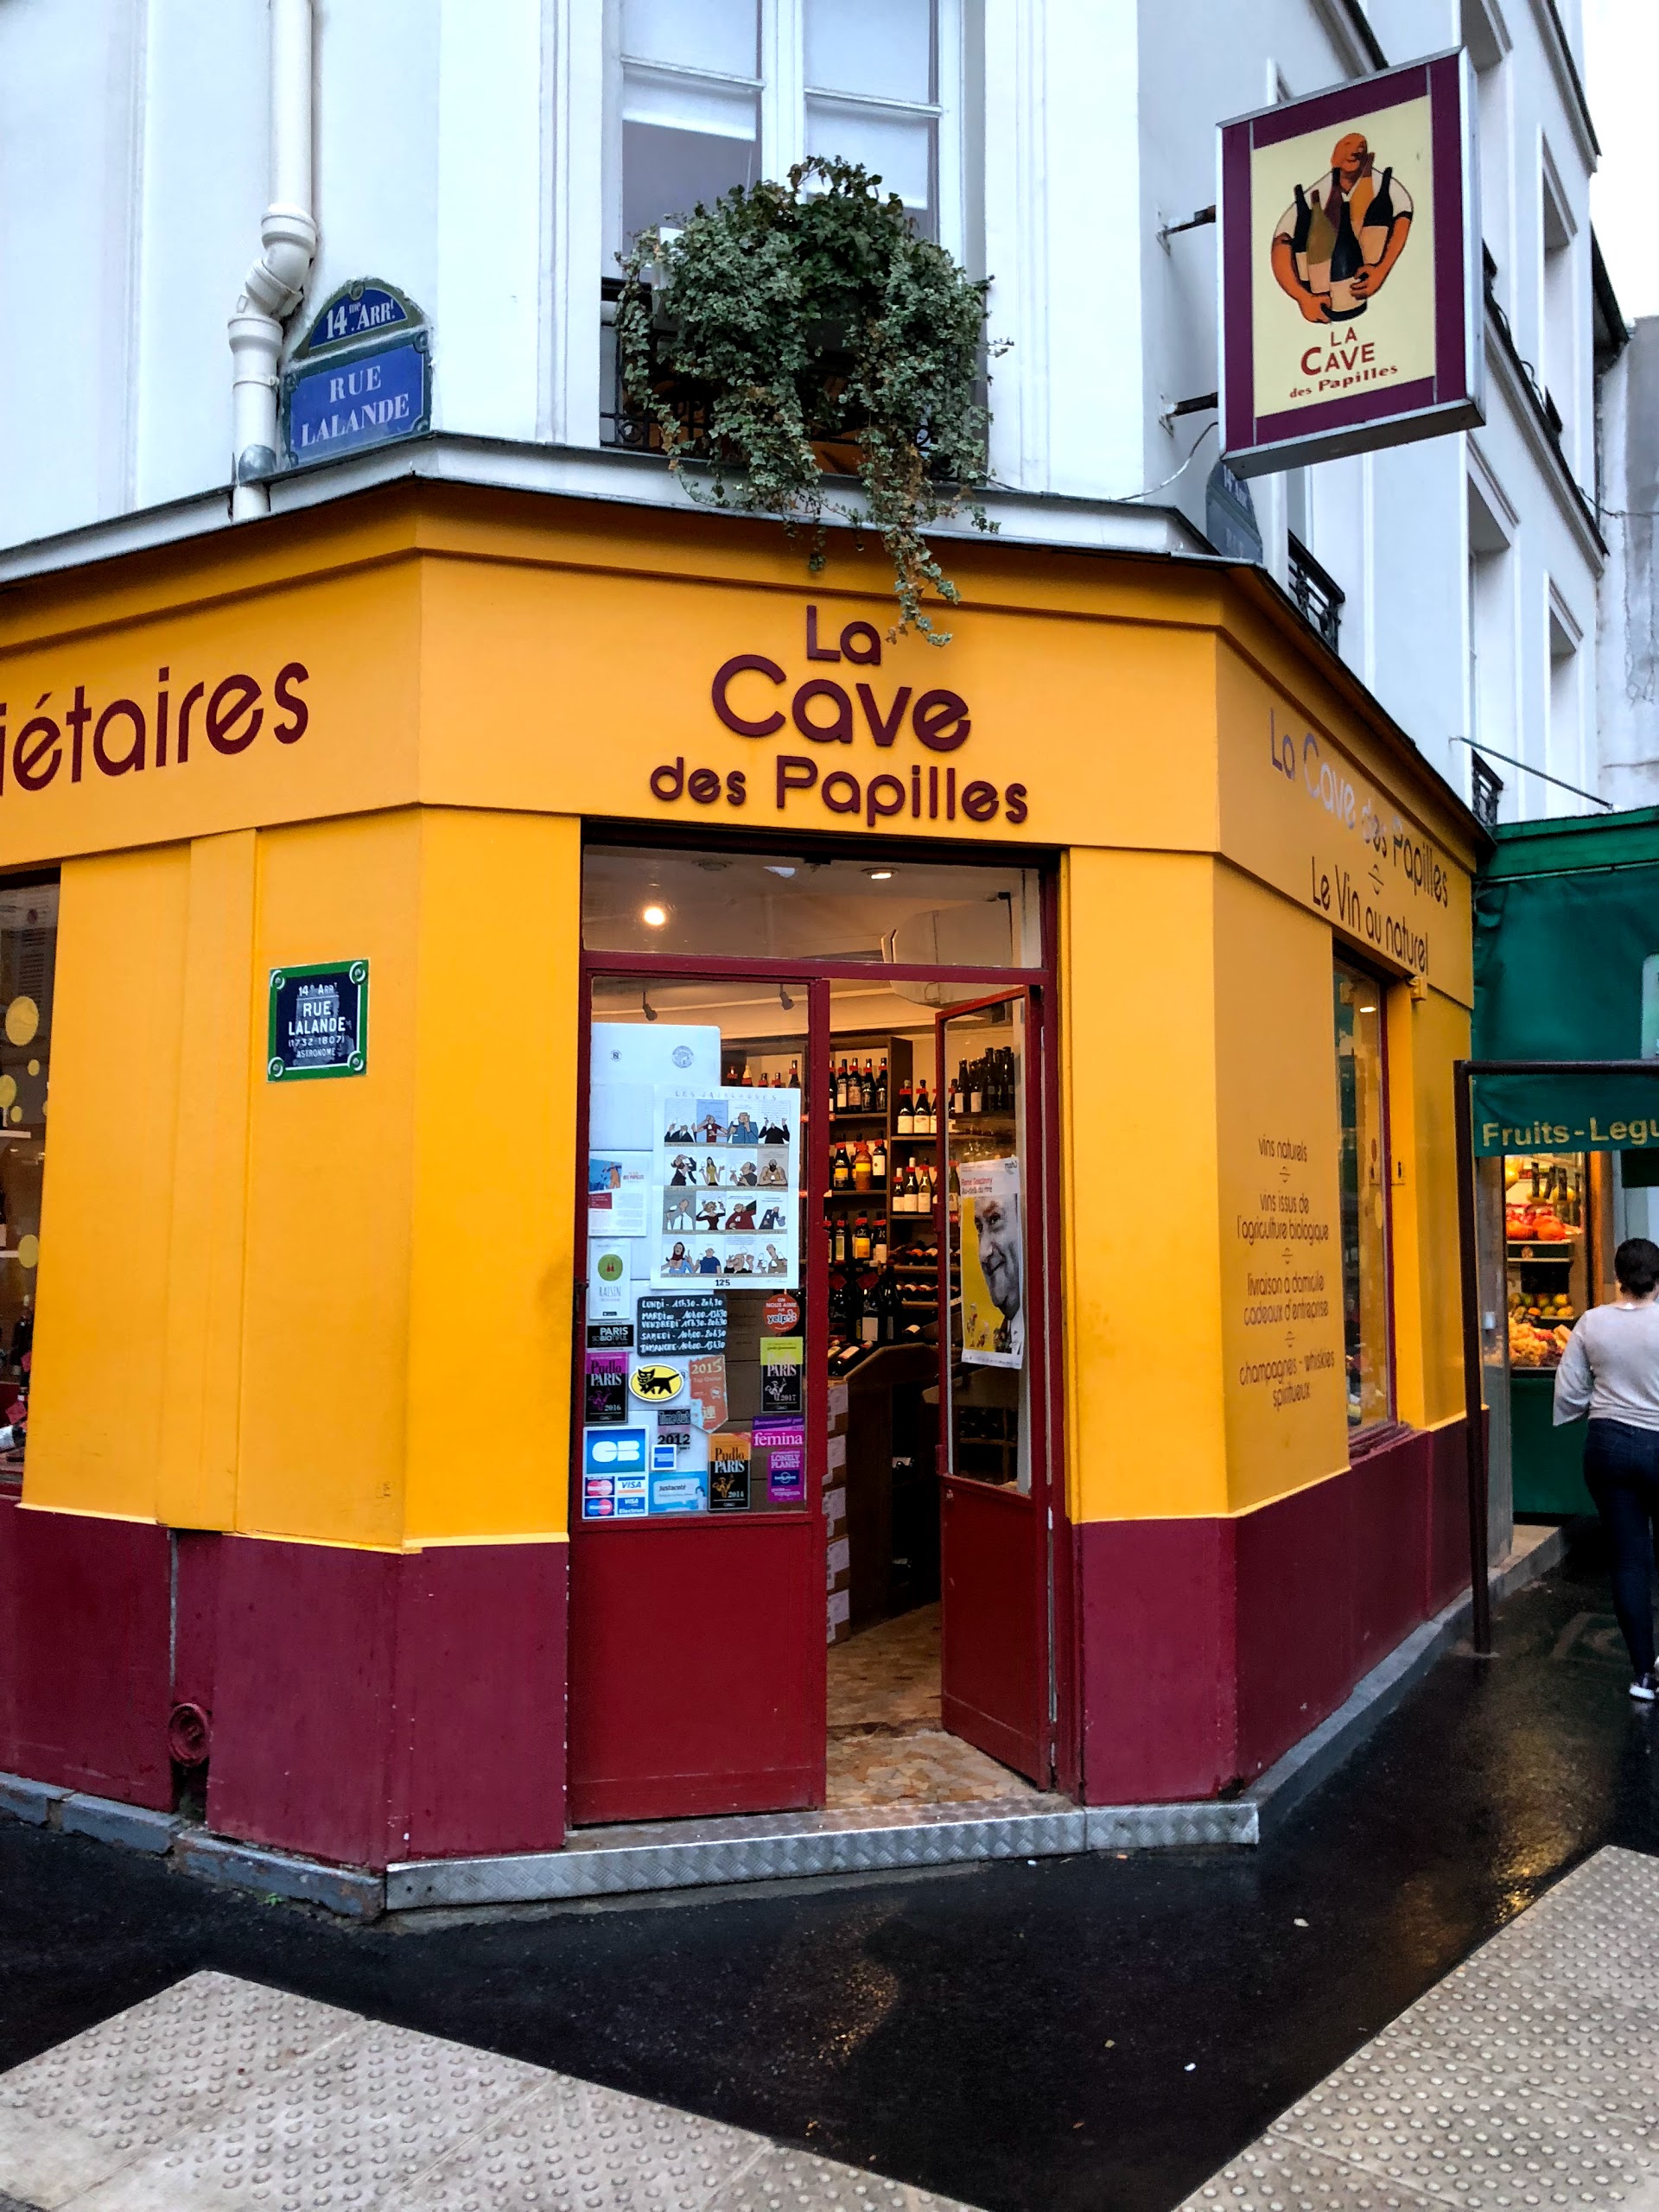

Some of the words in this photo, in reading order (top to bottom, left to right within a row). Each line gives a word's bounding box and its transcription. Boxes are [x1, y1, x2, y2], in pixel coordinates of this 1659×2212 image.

[1331, 327, 1357, 346] LA
[1300, 342, 1375, 376] CAVE
[329, 365, 381, 404] RUE
[1289, 385, 1312, 399] des
[1318, 363, 1399, 393] Papilles
[301, 393, 410, 448] LALANDE
[806, 604, 881, 666] La
[711, 654, 972, 752] Cave
[650, 756, 747, 806] des
[777, 754, 1028, 828] Papilles
[1269, 707, 1296, 782] La
[1303, 732, 1356, 830] Cave
[1362, 798, 1388, 858] des
[1393, 815, 1448, 911] Papilles
[1311, 855, 1331, 911] Le
[1334, 863, 1362, 933] Vin
[1365, 906, 1382, 944] au
[1385, 916, 1430, 976] naturel
[302, 1001, 331, 1017] RUE
[288, 1016, 346, 1036] LALANDE
[296, 1046, 336, 1058] ASTRONOME
[1258, 1136, 1275, 1158] vins
[1277, 1138, 1307, 1164] naturels
[1260, 1192, 1276, 1213] vins
[1277, 1192, 1297, 1213] issus
[1298, 1193, 1309, 1214] de
[1247, 1272, 1282, 1297] livraison
[767, 1313, 788, 1325] yelp
[1243, 1301, 1283, 1326] cadeaux
[600, 1326, 629, 1337] PARIS
[691, 1357, 722, 1375] 2015
[767, 1363, 797, 1377] PARIS
[590, 1372, 622, 1387] PARIS
[657, 1433, 690, 1445] 2012
[715, 1447, 744, 1461] Pudlo
[715, 1459, 745, 1473] PARIS
